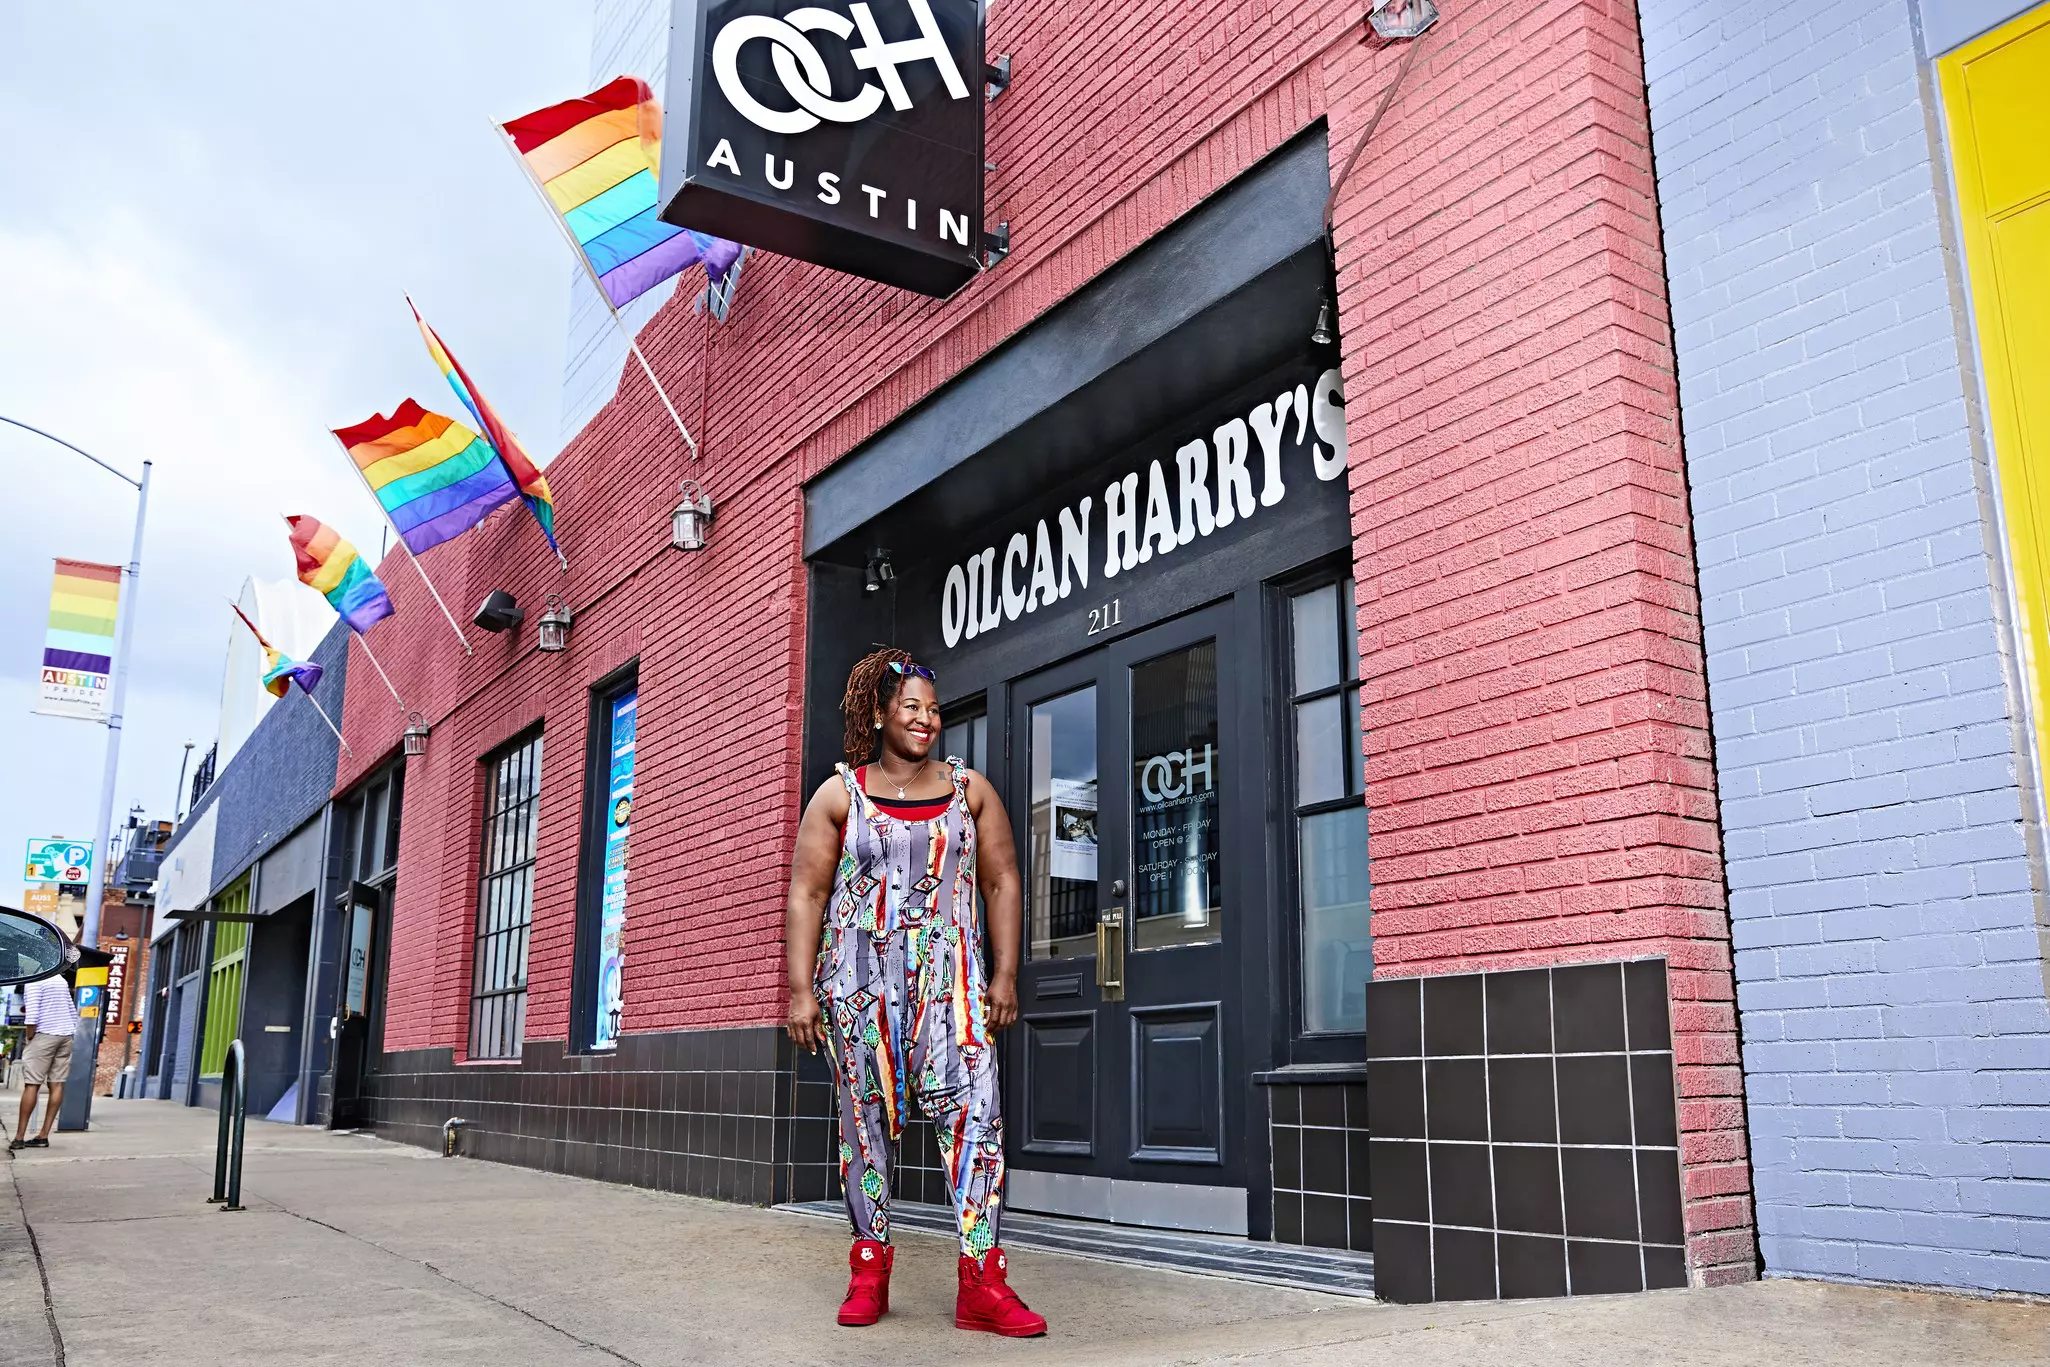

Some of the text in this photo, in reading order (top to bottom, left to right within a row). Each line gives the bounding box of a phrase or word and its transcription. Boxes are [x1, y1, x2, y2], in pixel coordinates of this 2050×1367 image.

[712, 0, 970, 133] OCH
[706, 138, 968, 247] AUSTIN
[942, 368, 1346, 648] OILCAN HARRY'S
[1088, 598, 1121, 635] 211
[43, 671, 106, 689] AUSTIN
[53, 686, 94, 697] PRIDE
[1141, 743, 1212, 803] OCH
[1139, 791, 1215, 814] www.oilcanharrys.com
[1143, 825, 1176, 840] MONDAY
[1152, 837, 1174, 849] OPEN
[1138, 859, 1177, 873] SATURDAY
[1184, 851, 1217, 864] SUNDAY
[106, 954, 127, 1023] MARKET
